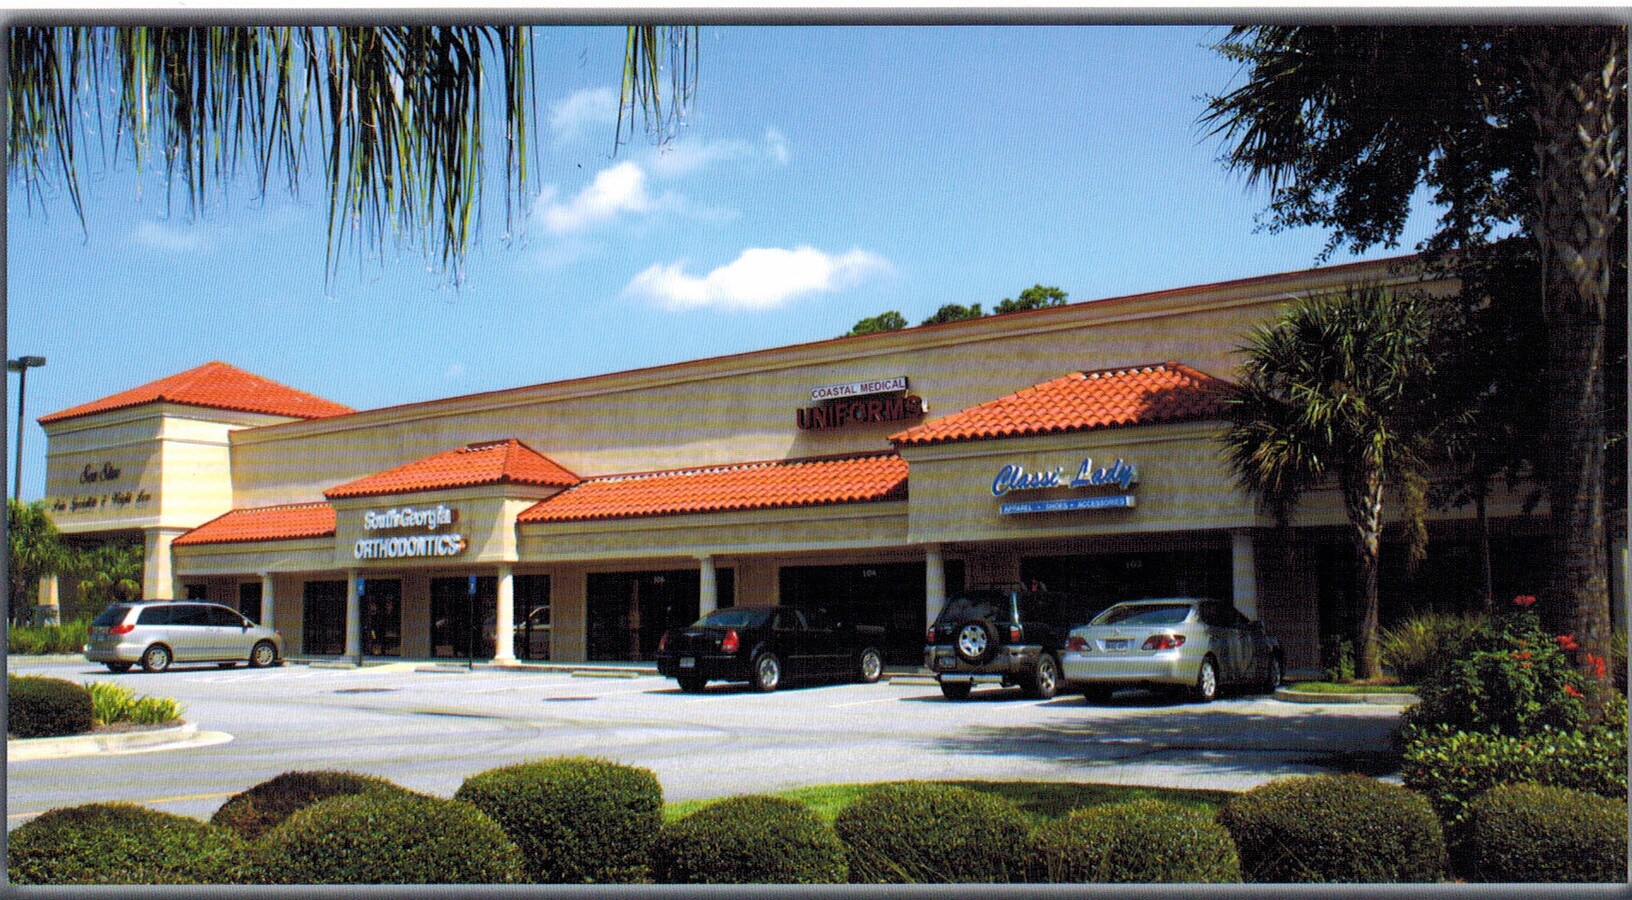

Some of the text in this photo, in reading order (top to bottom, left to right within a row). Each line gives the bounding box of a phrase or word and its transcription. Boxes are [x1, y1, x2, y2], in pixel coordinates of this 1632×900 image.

[811, 379, 905, 399] COASTAL MEDICAL
[797, 395, 923, 430] UNIFORMS
[1069, 457, 1135, 489] Lady
[364, 505, 452, 530] South Georgia
[1045, 499, 1069, 511] SHOES
[354, 533, 462, 559] ORTHODONTICS
